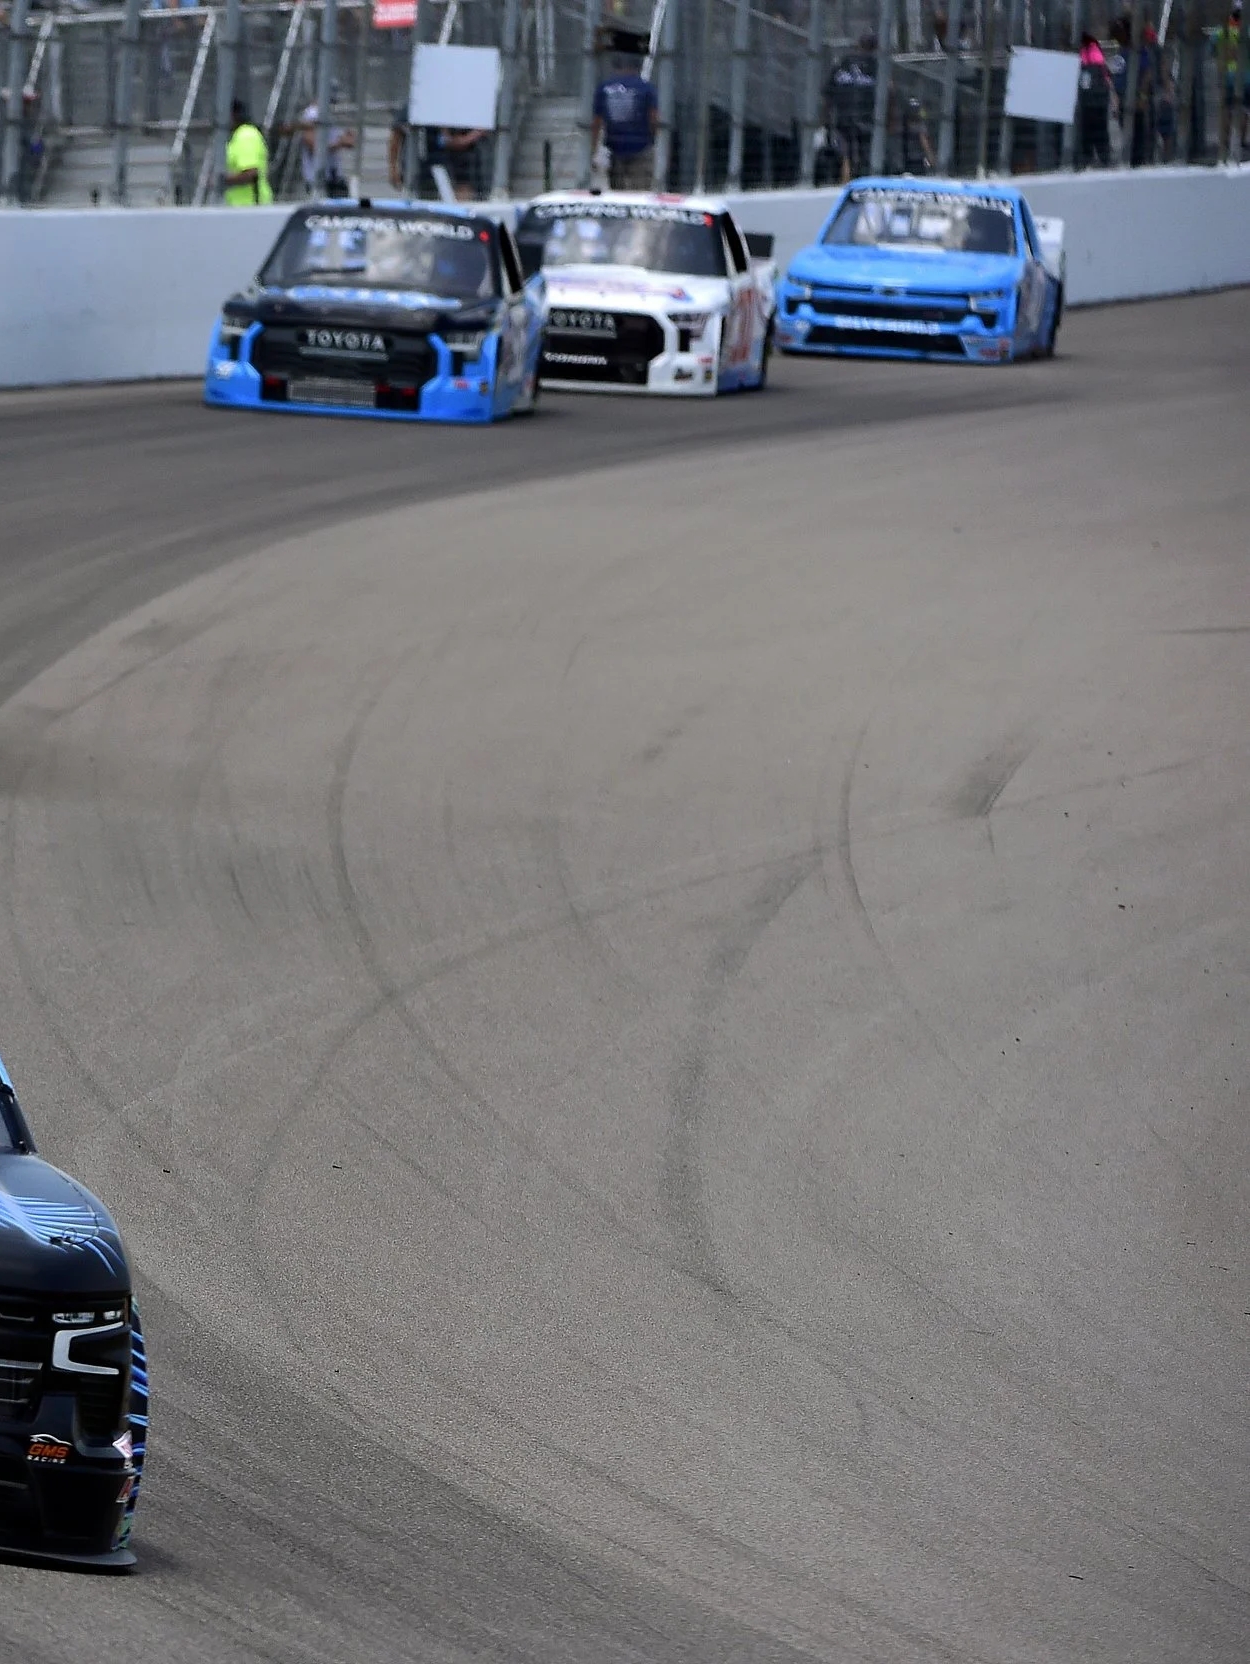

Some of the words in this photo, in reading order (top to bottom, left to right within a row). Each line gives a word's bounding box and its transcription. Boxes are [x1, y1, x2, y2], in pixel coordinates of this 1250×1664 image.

[304, 214, 396, 233] CAMPING
[398, 219, 475, 241] WORLD
[305, 328, 387, 351] TOYOTA
[29, 1443, 70, 1458] GMS
